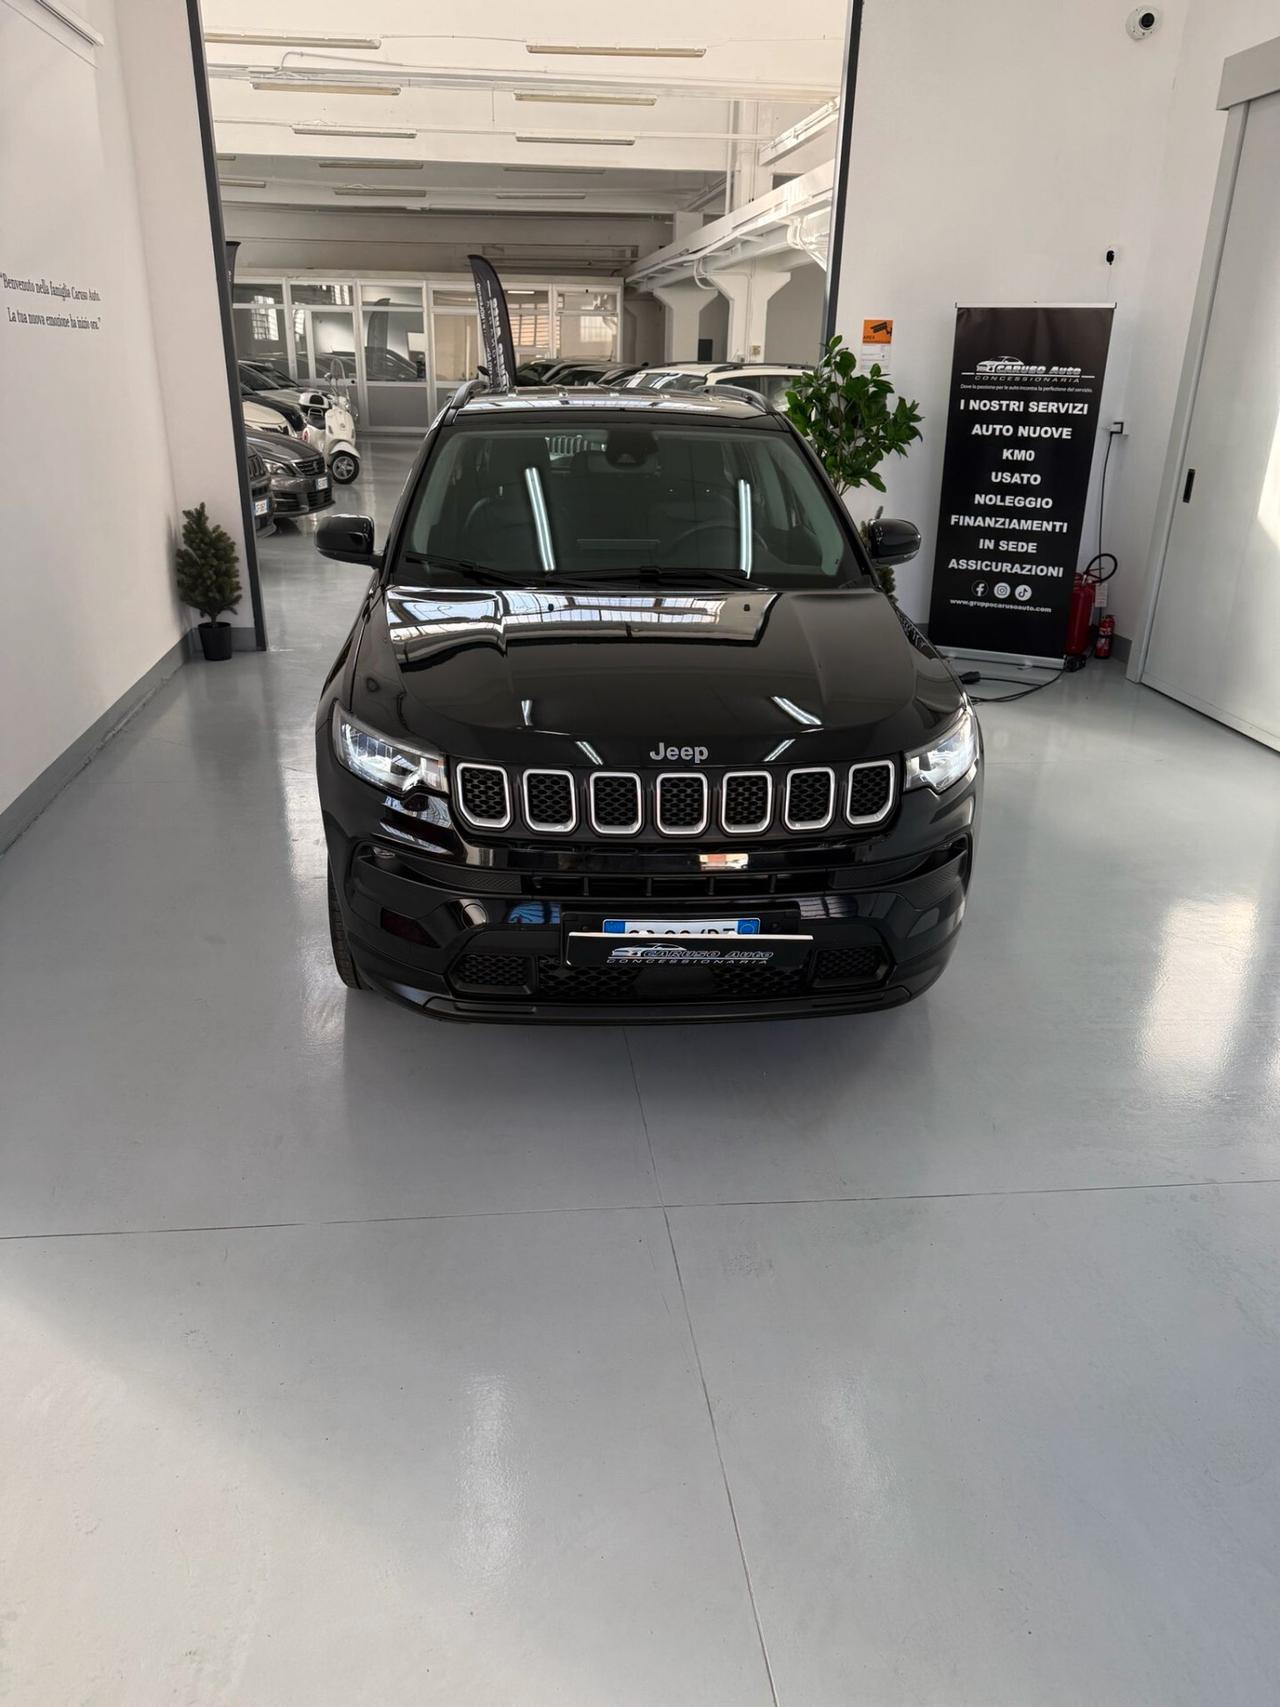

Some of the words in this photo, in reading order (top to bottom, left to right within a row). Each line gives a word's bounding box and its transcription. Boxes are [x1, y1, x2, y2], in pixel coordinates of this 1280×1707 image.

[35, 279, 50, 294] nella
[50, 280, 71, 301] famiglia
[7, 306, 17, 322] La
[16, 309, 28, 323] tua
[28, 313, 45, 325] nuova
[959, 399, 965, 410] I
[969, 399, 1024, 412] NOSTRI
[1028, 401, 1088, 415] SERVIZI
[971, 424, 1014, 436] AUTO
[1017, 426, 1072, 439] NUOVE
[991, 471, 1042, 485] USATO
[974, 494, 1053, 508] NOLEGGIO
[950, 514, 1068, 533] FINANZIAMENTI
[978, 538, 995, 550] IN
[998, 540, 1038, 553] SEDE
[948, 558, 1064, 578] ASSICURAZIONI
[950, 599, 1052, 613] www.gruppocarusoauto.com
[649, 742, 709, 763] Jeep
